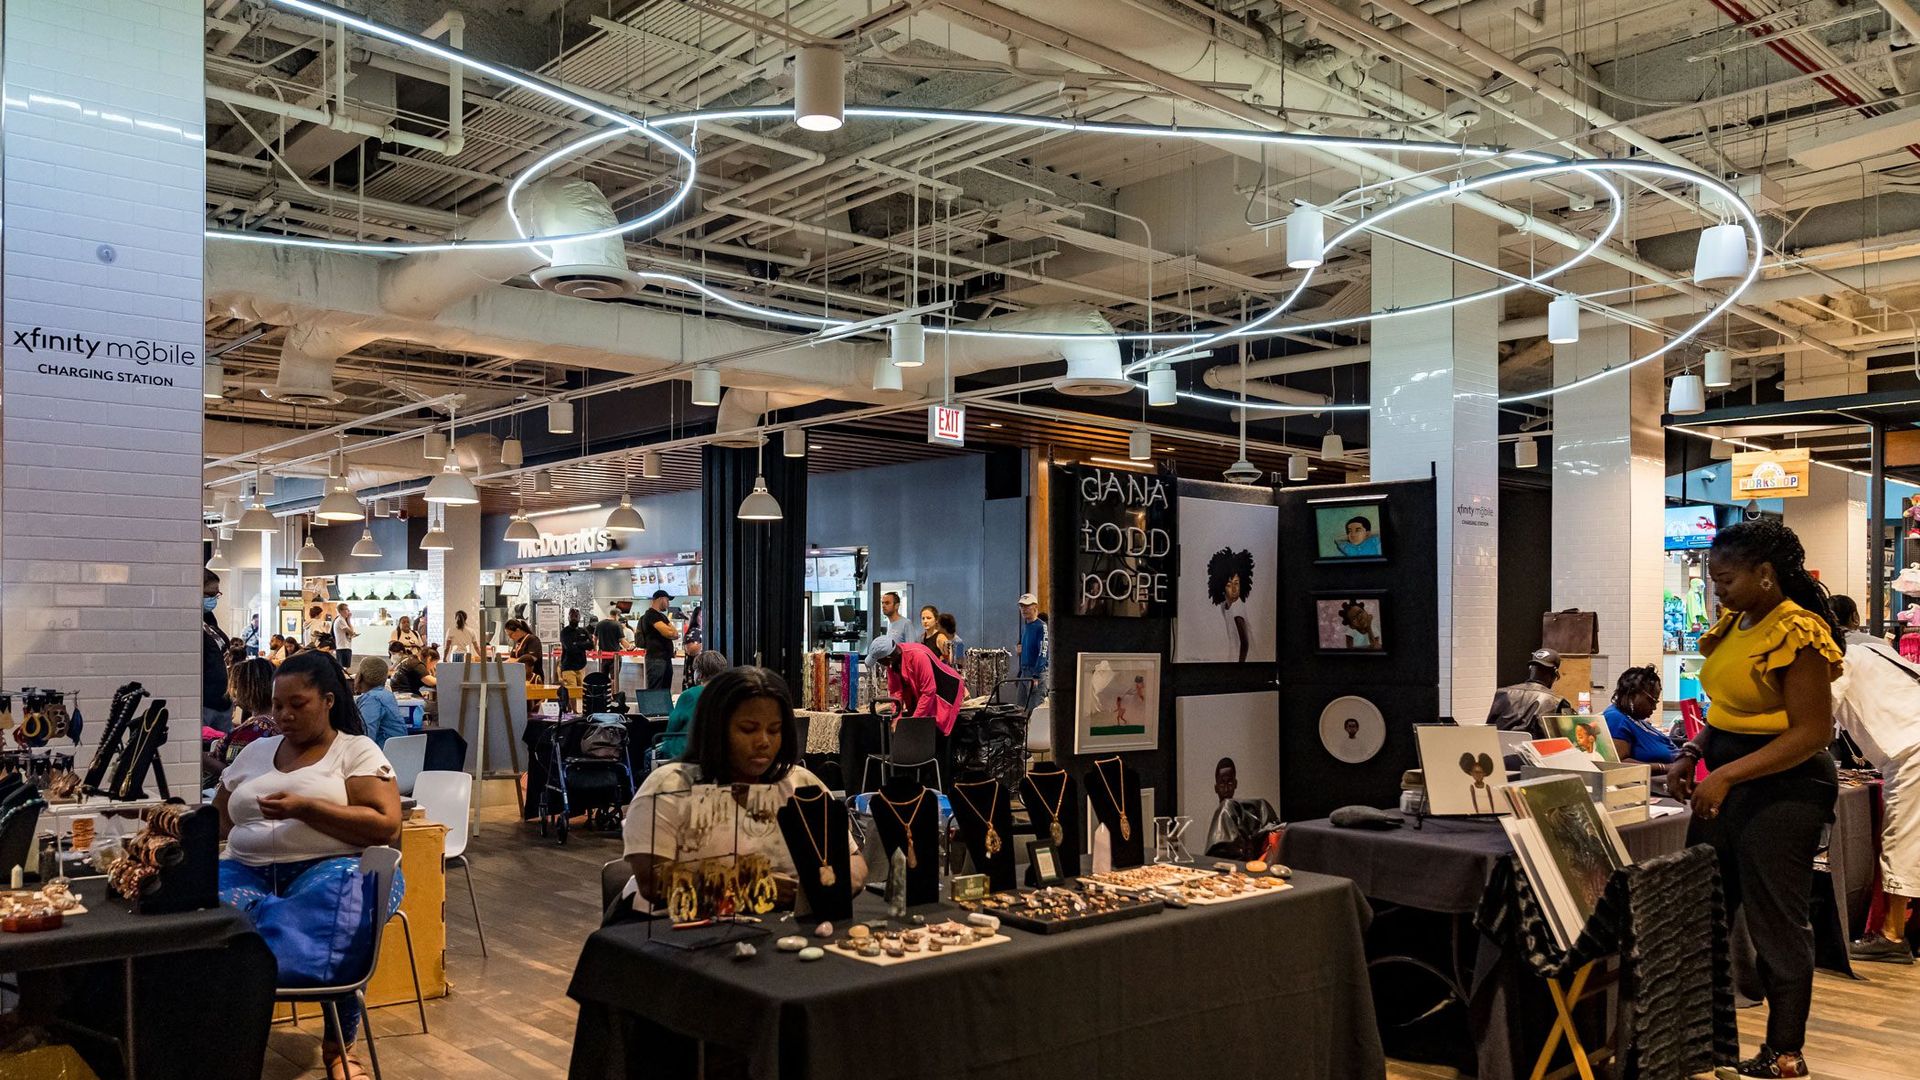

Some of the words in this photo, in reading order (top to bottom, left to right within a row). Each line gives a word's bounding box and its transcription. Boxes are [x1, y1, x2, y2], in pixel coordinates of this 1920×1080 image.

[13, 327, 100, 359] xfinity
[107, 340, 195, 365] mobile
[37, 363, 114, 381] CHARGING
[117, 372, 173, 387] STATION
[939, 407, 959, 432] EXIT
[517, 527, 612, 558] McDonald's
[1153, 816, 1194, 863] K
